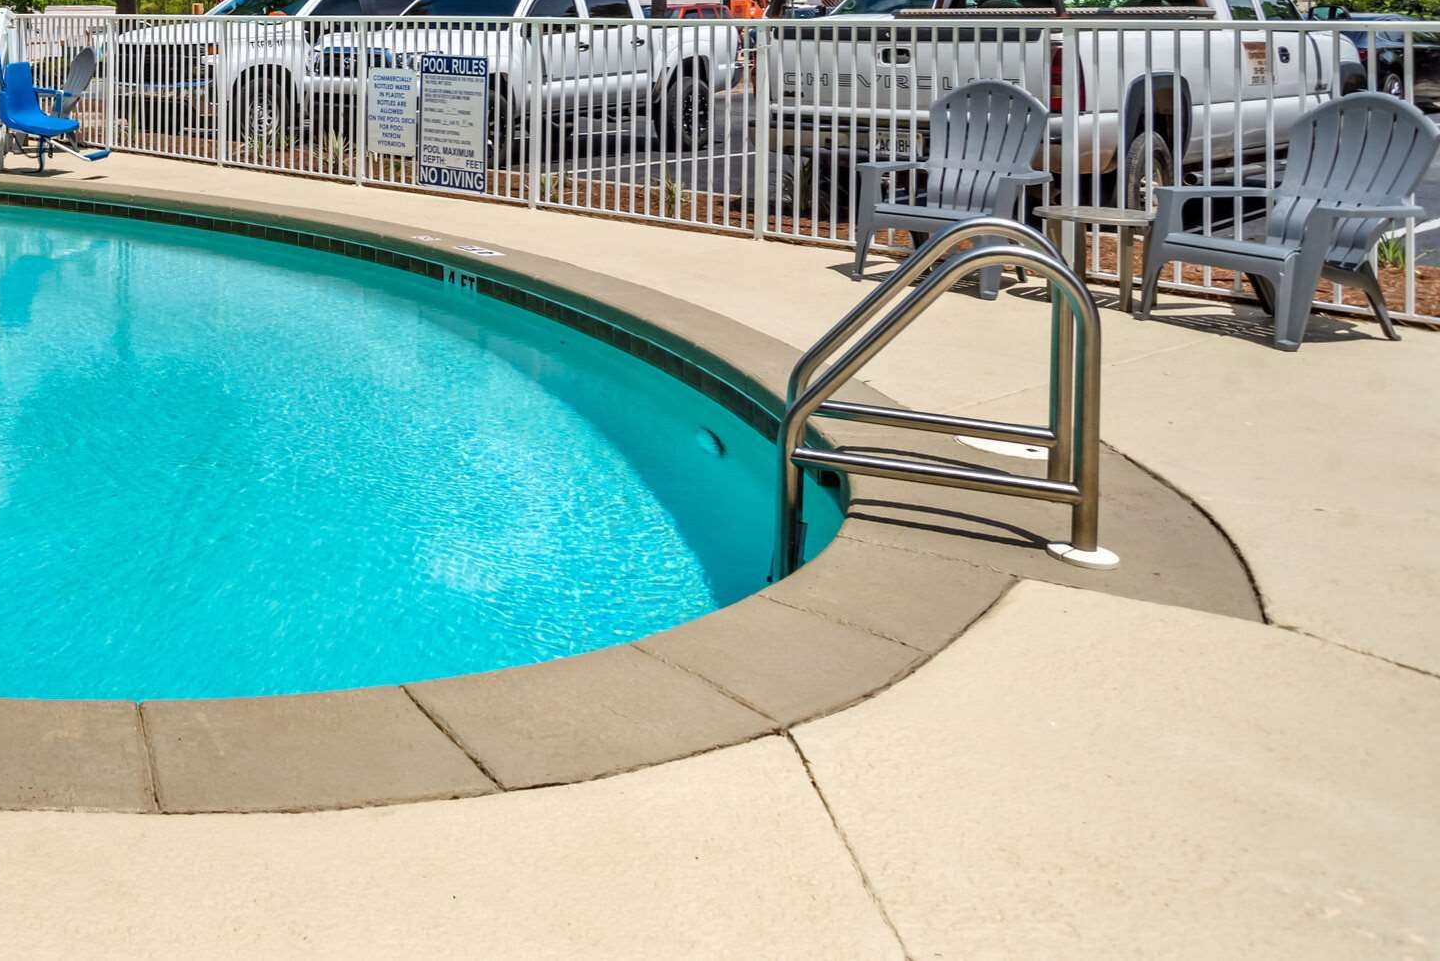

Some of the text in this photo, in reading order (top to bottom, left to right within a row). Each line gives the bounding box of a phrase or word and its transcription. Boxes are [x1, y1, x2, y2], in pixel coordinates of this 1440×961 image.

[422, 57, 486, 75] POOL RULES
[782, 71, 1023, 90] CHEVROL
[378, 140, 406, 148] HYDRATION
[423, 144, 475, 158] POOL MAXIMUM
[465, 159, 485, 170] FEET
[420, 166, 484, 190] NO DIVING
